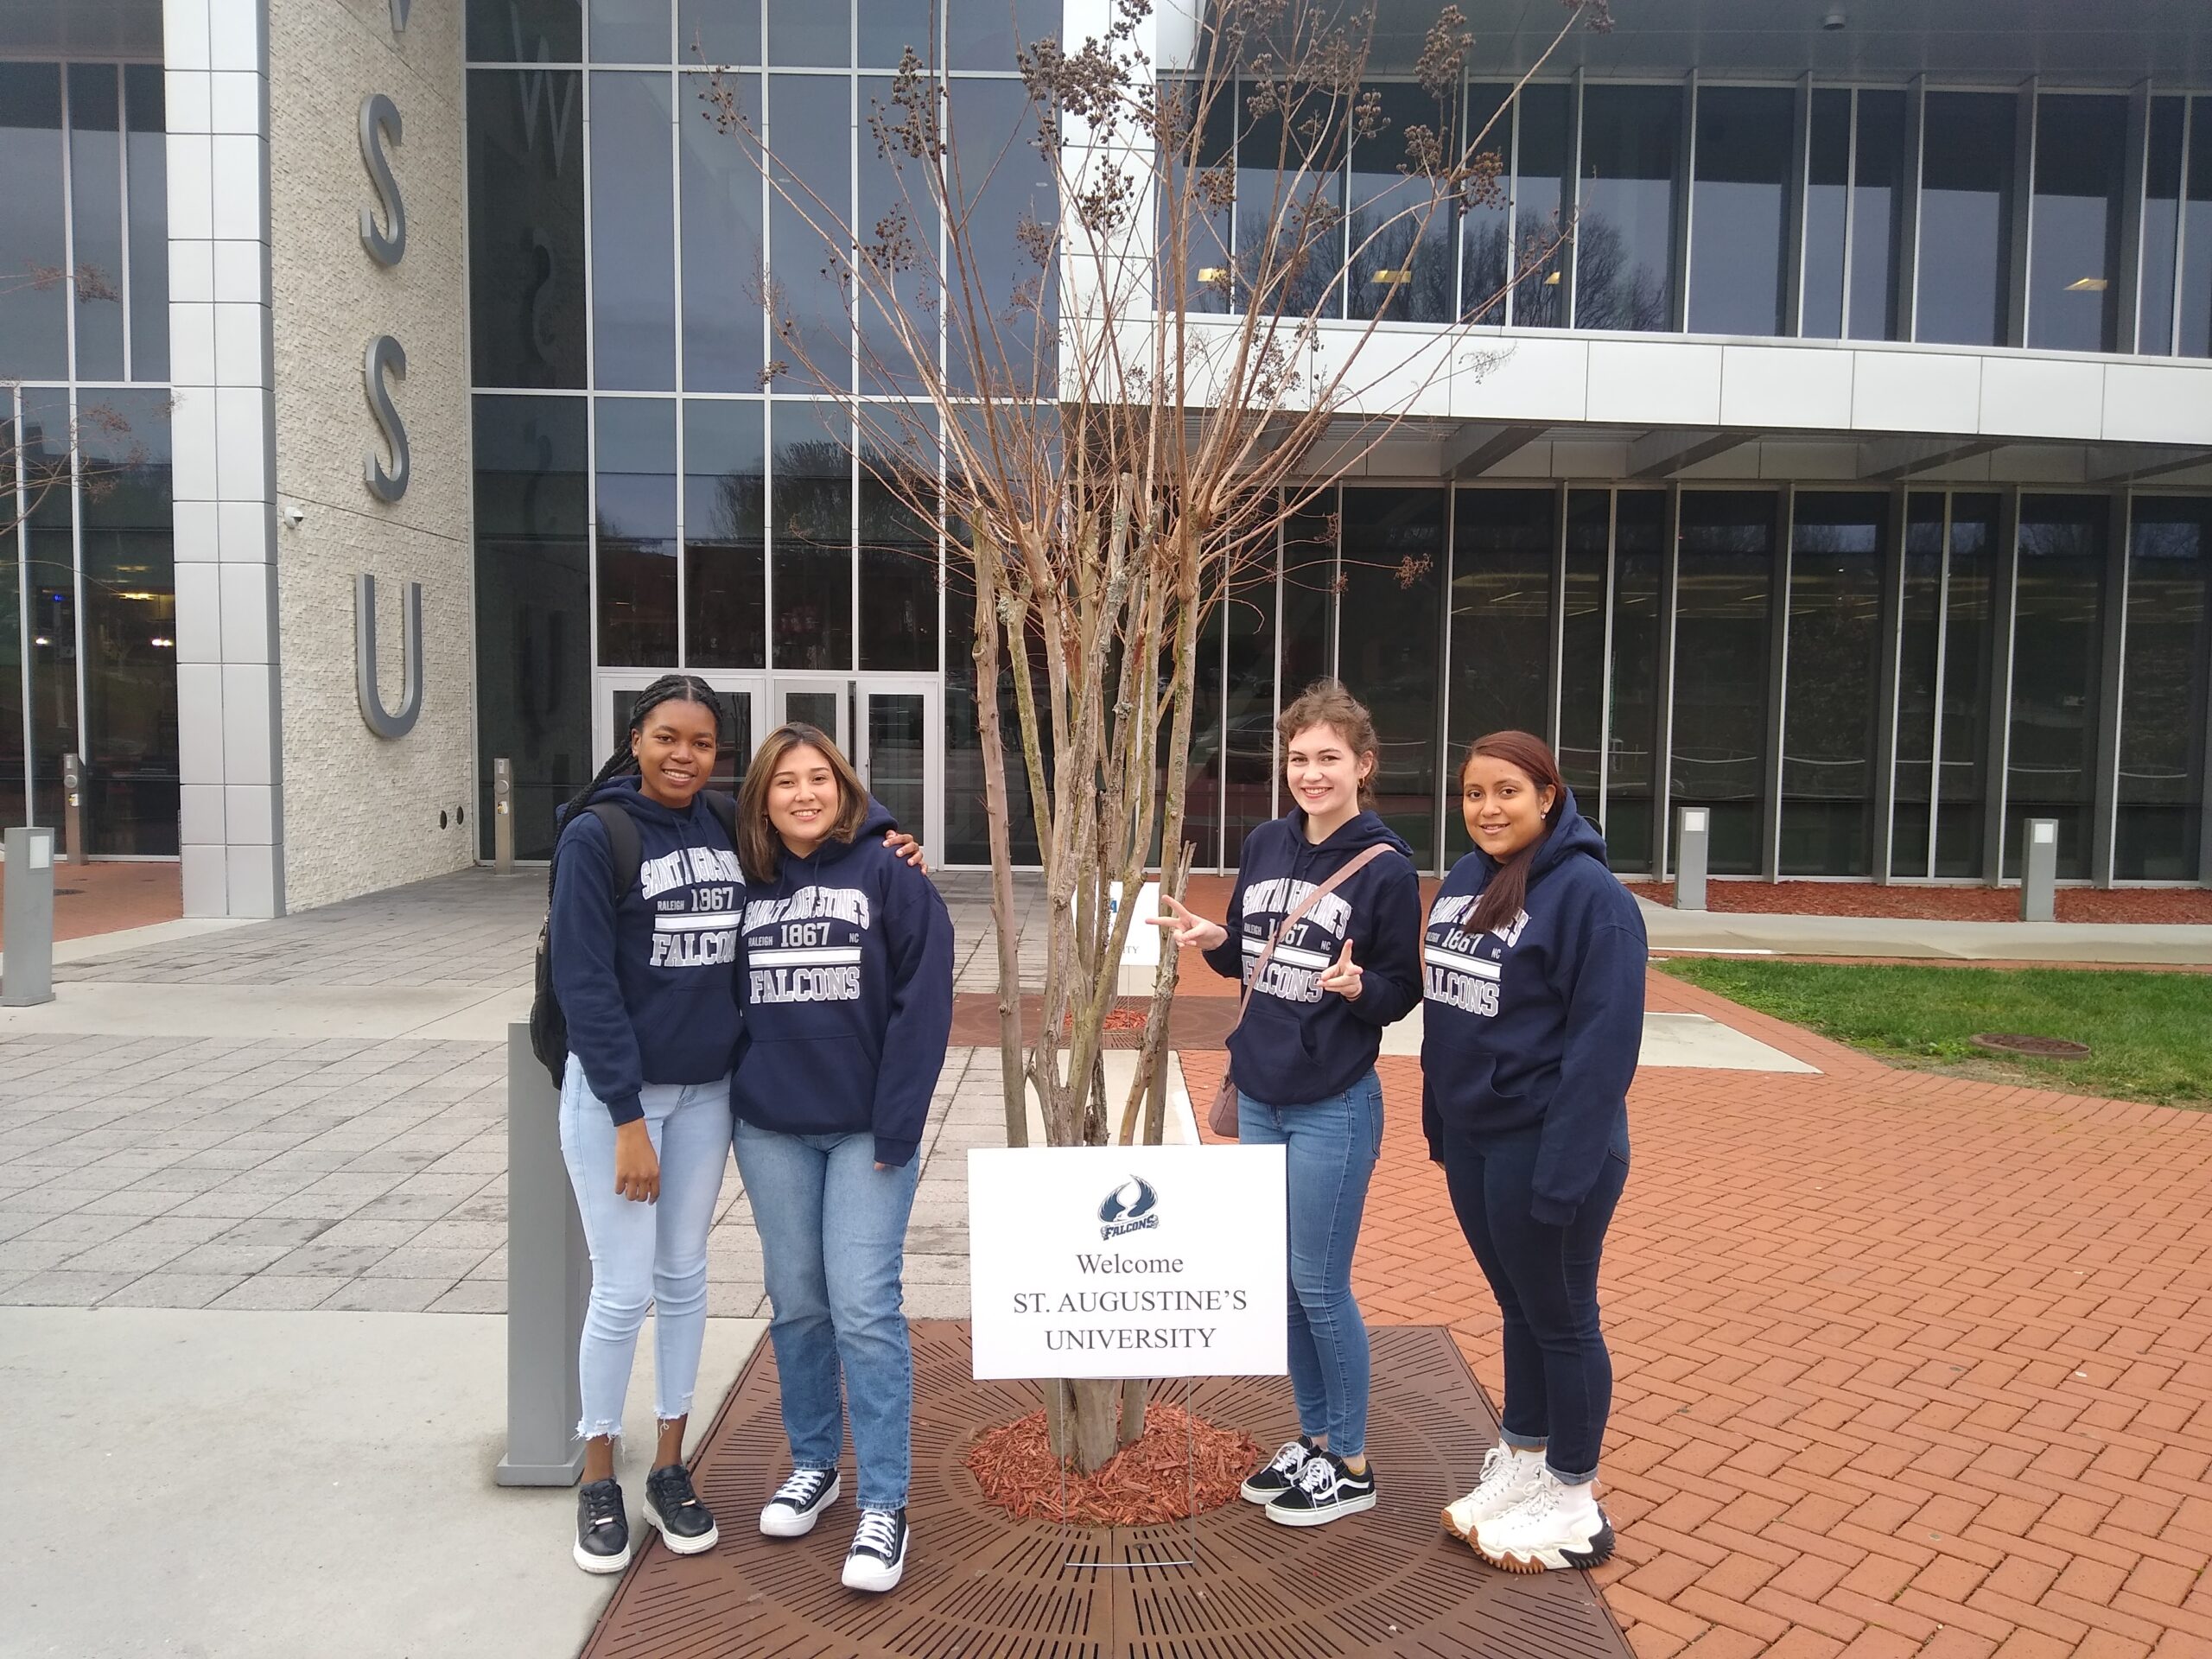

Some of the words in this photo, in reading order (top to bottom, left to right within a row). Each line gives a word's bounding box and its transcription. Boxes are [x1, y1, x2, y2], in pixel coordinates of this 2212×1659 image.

[640, 850, 684, 899] SAINT
[657, 900, 684, 912] RALEIGH
[691, 887, 734, 912] 1867
[741, 897, 791, 938] SAINT
[650, 930, 738, 967] FALCON
[747, 936, 773, 948] RALEIGH
[780, 922, 830, 948] 1867
[849, 932, 860, 944] NC
[1243, 922, 1262, 937] RALEIGH
[1267, 918, 1309, 947] 167
[1320, 940, 1331, 950] NC
[1441, 927, 1485, 955] 1867
[1491, 948, 1502, 959] NC
[749, 966, 861, 1004] FALCONS
[1423, 965, 1500, 1018] ALCONS
[1103, 1213, 1156, 1241] FALCONS
[1076, 1254, 1184, 1274] Welcome
[1013, 1293, 1051, 1313] ST.
[1057, 1289, 1248, 1313] AUGUSTINE'S
[1044, 1327, 1217, 1351] UNIVERSITY
